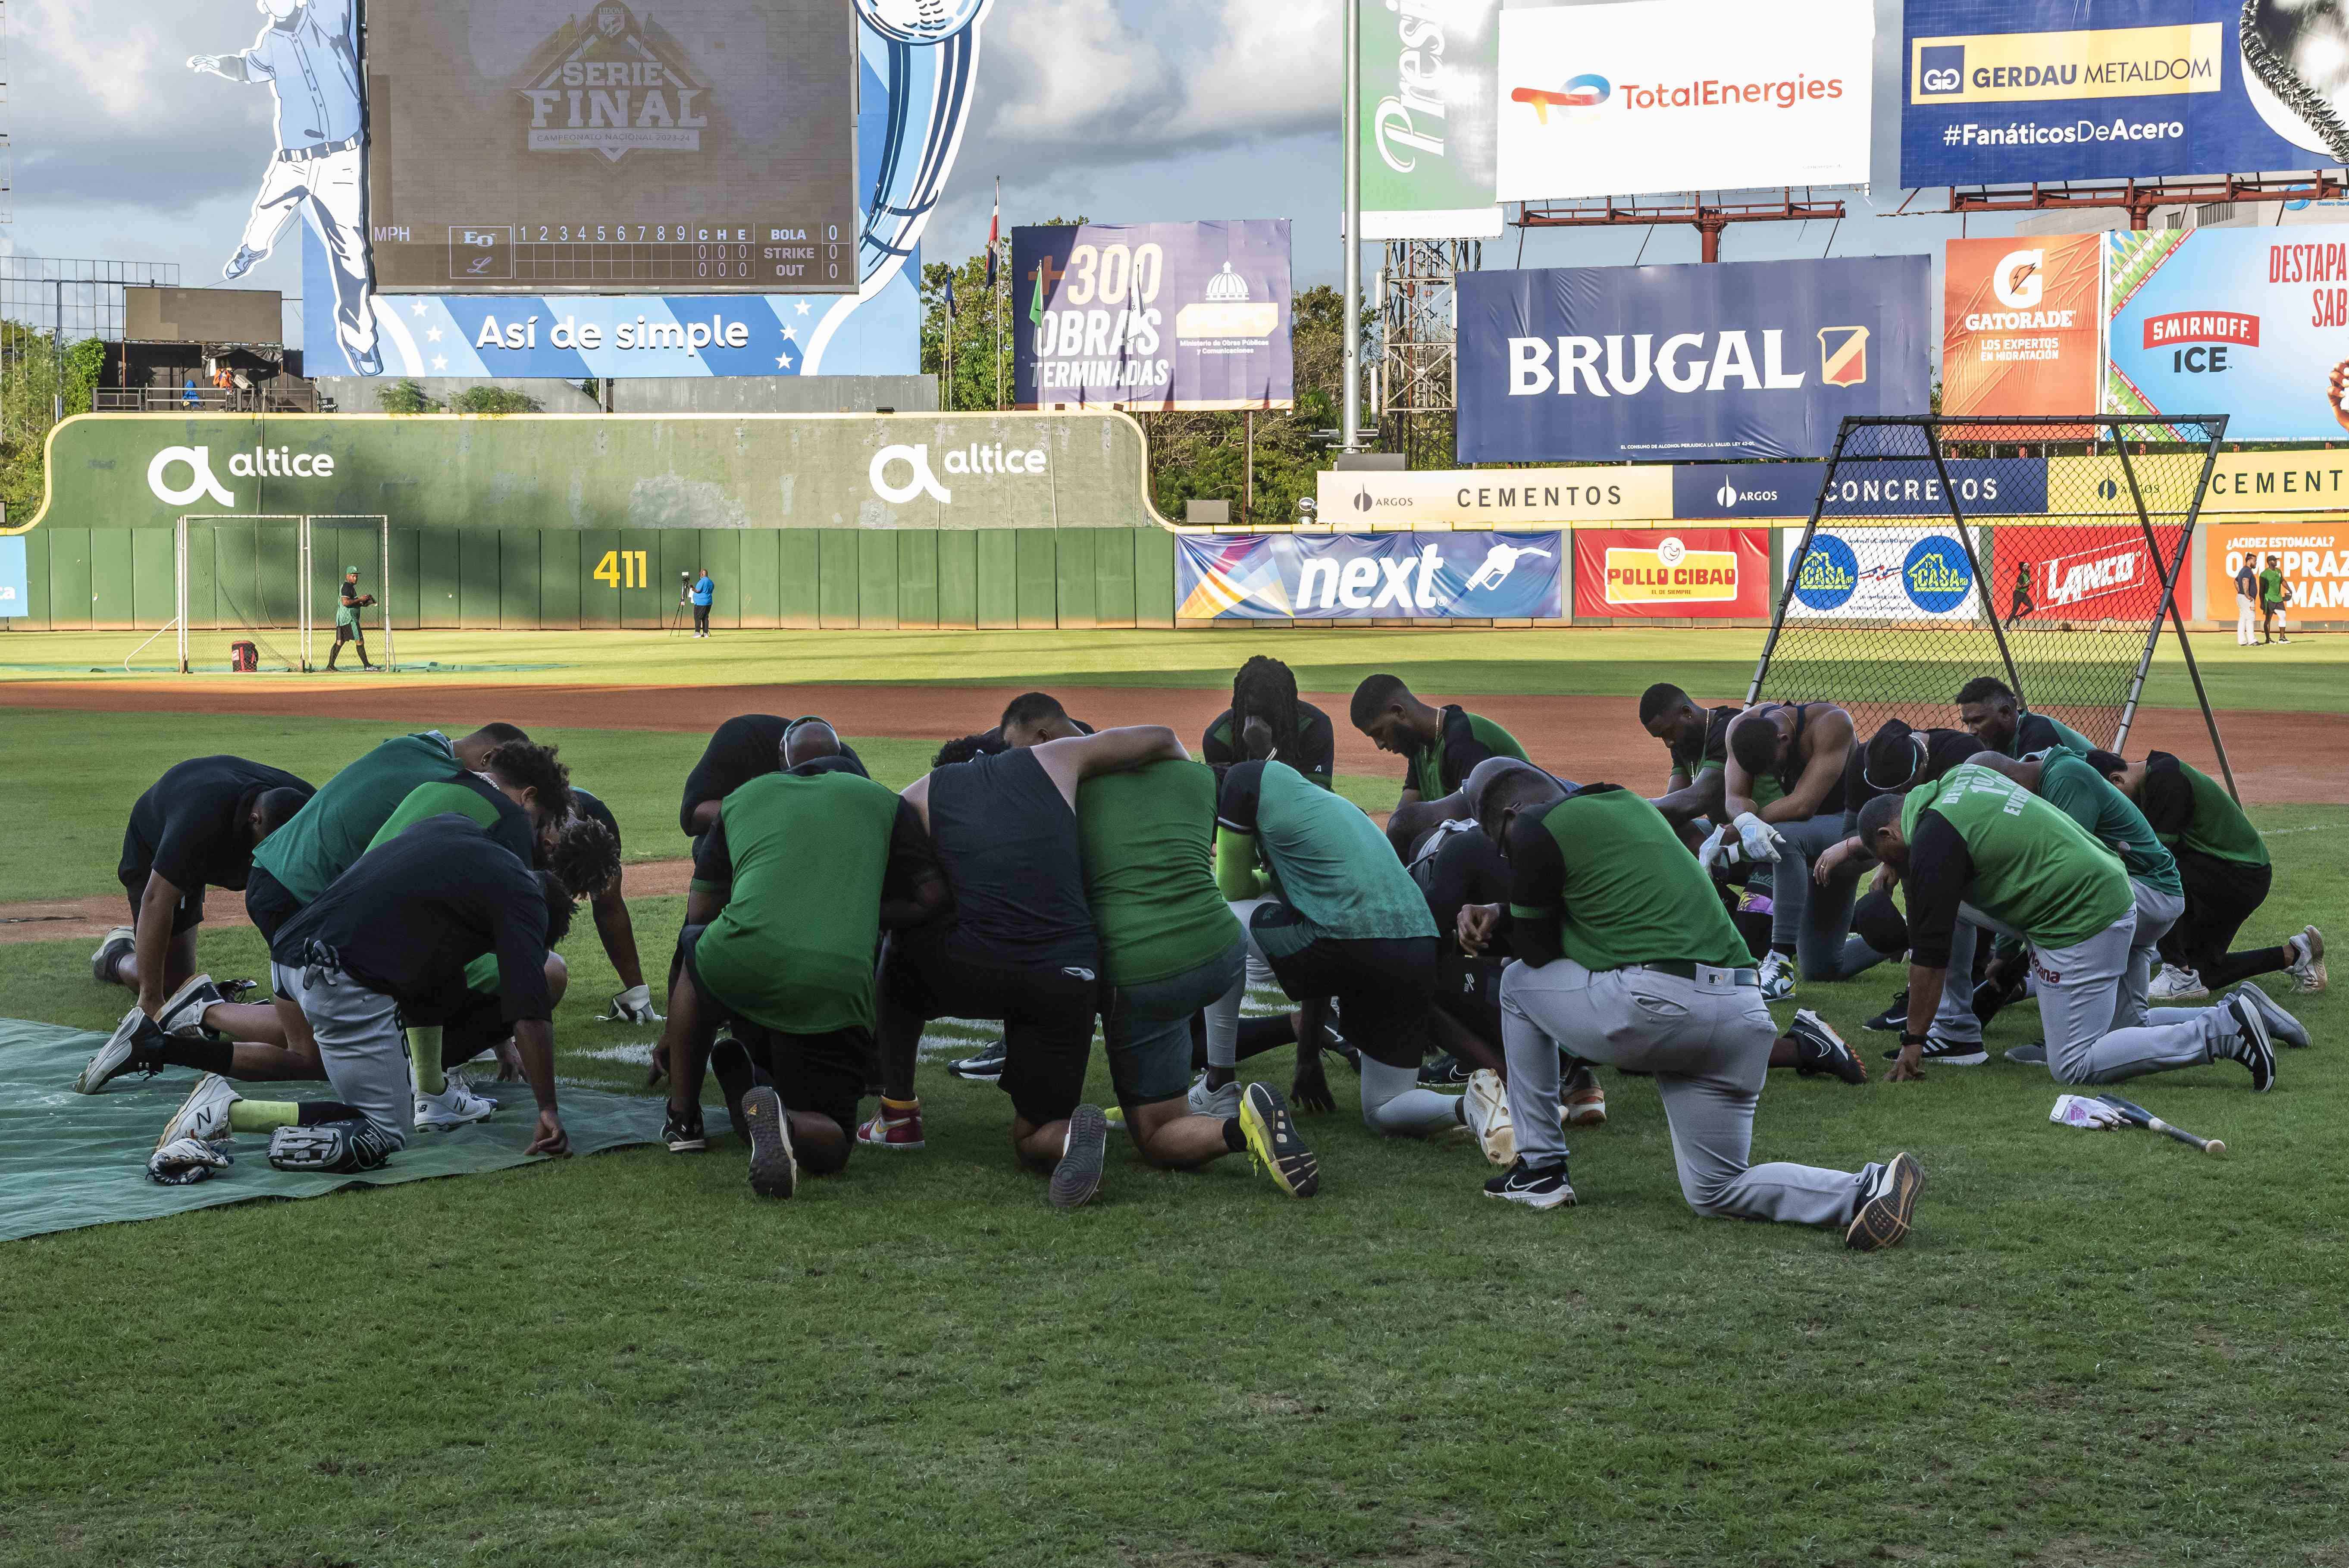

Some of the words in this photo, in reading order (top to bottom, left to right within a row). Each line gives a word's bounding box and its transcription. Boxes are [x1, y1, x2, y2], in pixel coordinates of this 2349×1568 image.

[563, 62, 663, 86] SERIE
[1973, 64, 2077, 88] GERDAU
[2084, 58, 2211, 84] METALDOM
[1619, 74, 1842, 110] TotalEnergies
[520, 90, 708, 127] FINAL
[1943, 118, 2183, 146] #FanáticosDeAcero
[374, 226, 410, 242] MPH
[521, 225, 526, 241] 1
[540, 225, 548, 241] 2
[560, 225, 568, 241] 3
[578, 225, 586, 241] 4
[597, 225, 605, 241] 5
[617, 225, 625, 241] 6
[638, 225, 646, 241] 7
[657, 225, 665, 241] 8
[677, 225, 685, 241] 9
[698, 229, 708, 240] C
[717, 229, 727, 240] H
[738, 229, 745, 240] E
[771, 229, 806, 240] BOLA
[829, 225, 837, 241] 0
[698, 244, 707, 259] 0
[718, 244, 726, 259] 0
[739, 244, 747, 259] 0
[764, 247, 815, 259] STRIKE
[829, 244, 837, 259] 0
[2270, 243, 2347, 283] DESTAPA
[699, 263, 707, 277] 0
[718, 263, 726, 277] 0
[739, 263, 747, 277] 0
[776, 264, 805, 276] OUT
[830, 263, 838, 279] 0
[1027, 243, 1163, 305] +300
[2312, 288, 2349, 327] SAB
[1032, 308, 1162, 357] OBRAS
[1965, 310, 2073, 331] GATORADE
[476, 315, 539, 349] Así
[550, 316, 601, 350] de
[616, 314, 749, 357] simple
[1981, 339, 2001, 351] LOS
[2004, 338, 2059, 349] EXPERTOS
[1507, 329, 1806, 397] BRUGAL
[1981, 351, 1994, 361] EN
[1996, 349, 2059, 361] HIDRATACIÓN
[2174, 347, 2227, 373] ICE
[1030, 359, 1169, 387] TERMINADAS
[229, 445, 335, 478] altice
[944, 442, 1046, 473] altice
[2212, 469, 2343, 494] CEMENT
[1376, 498, 1413, 506] ARGOS
[1457, 485, 1621, 507] CEMENTOS
[1739, 491, 1777, 501] ARGOS
[2226, 538, 2267, 550] ¿ACIDEZ
[2269, 536, 2335, 548] ESTOMACAL?
[593, 550, 647, 588] 411
[1296, 543, 1444, 609] next
[1607, 569, 1668, 585] POLLO
[1674, 569, 1735, 585] CIBAO
[1804, 566, 1845, 585] CASA
[1918, 568, 1960, 587] CASA
[2047, 551, 2135, 605] LANCO
